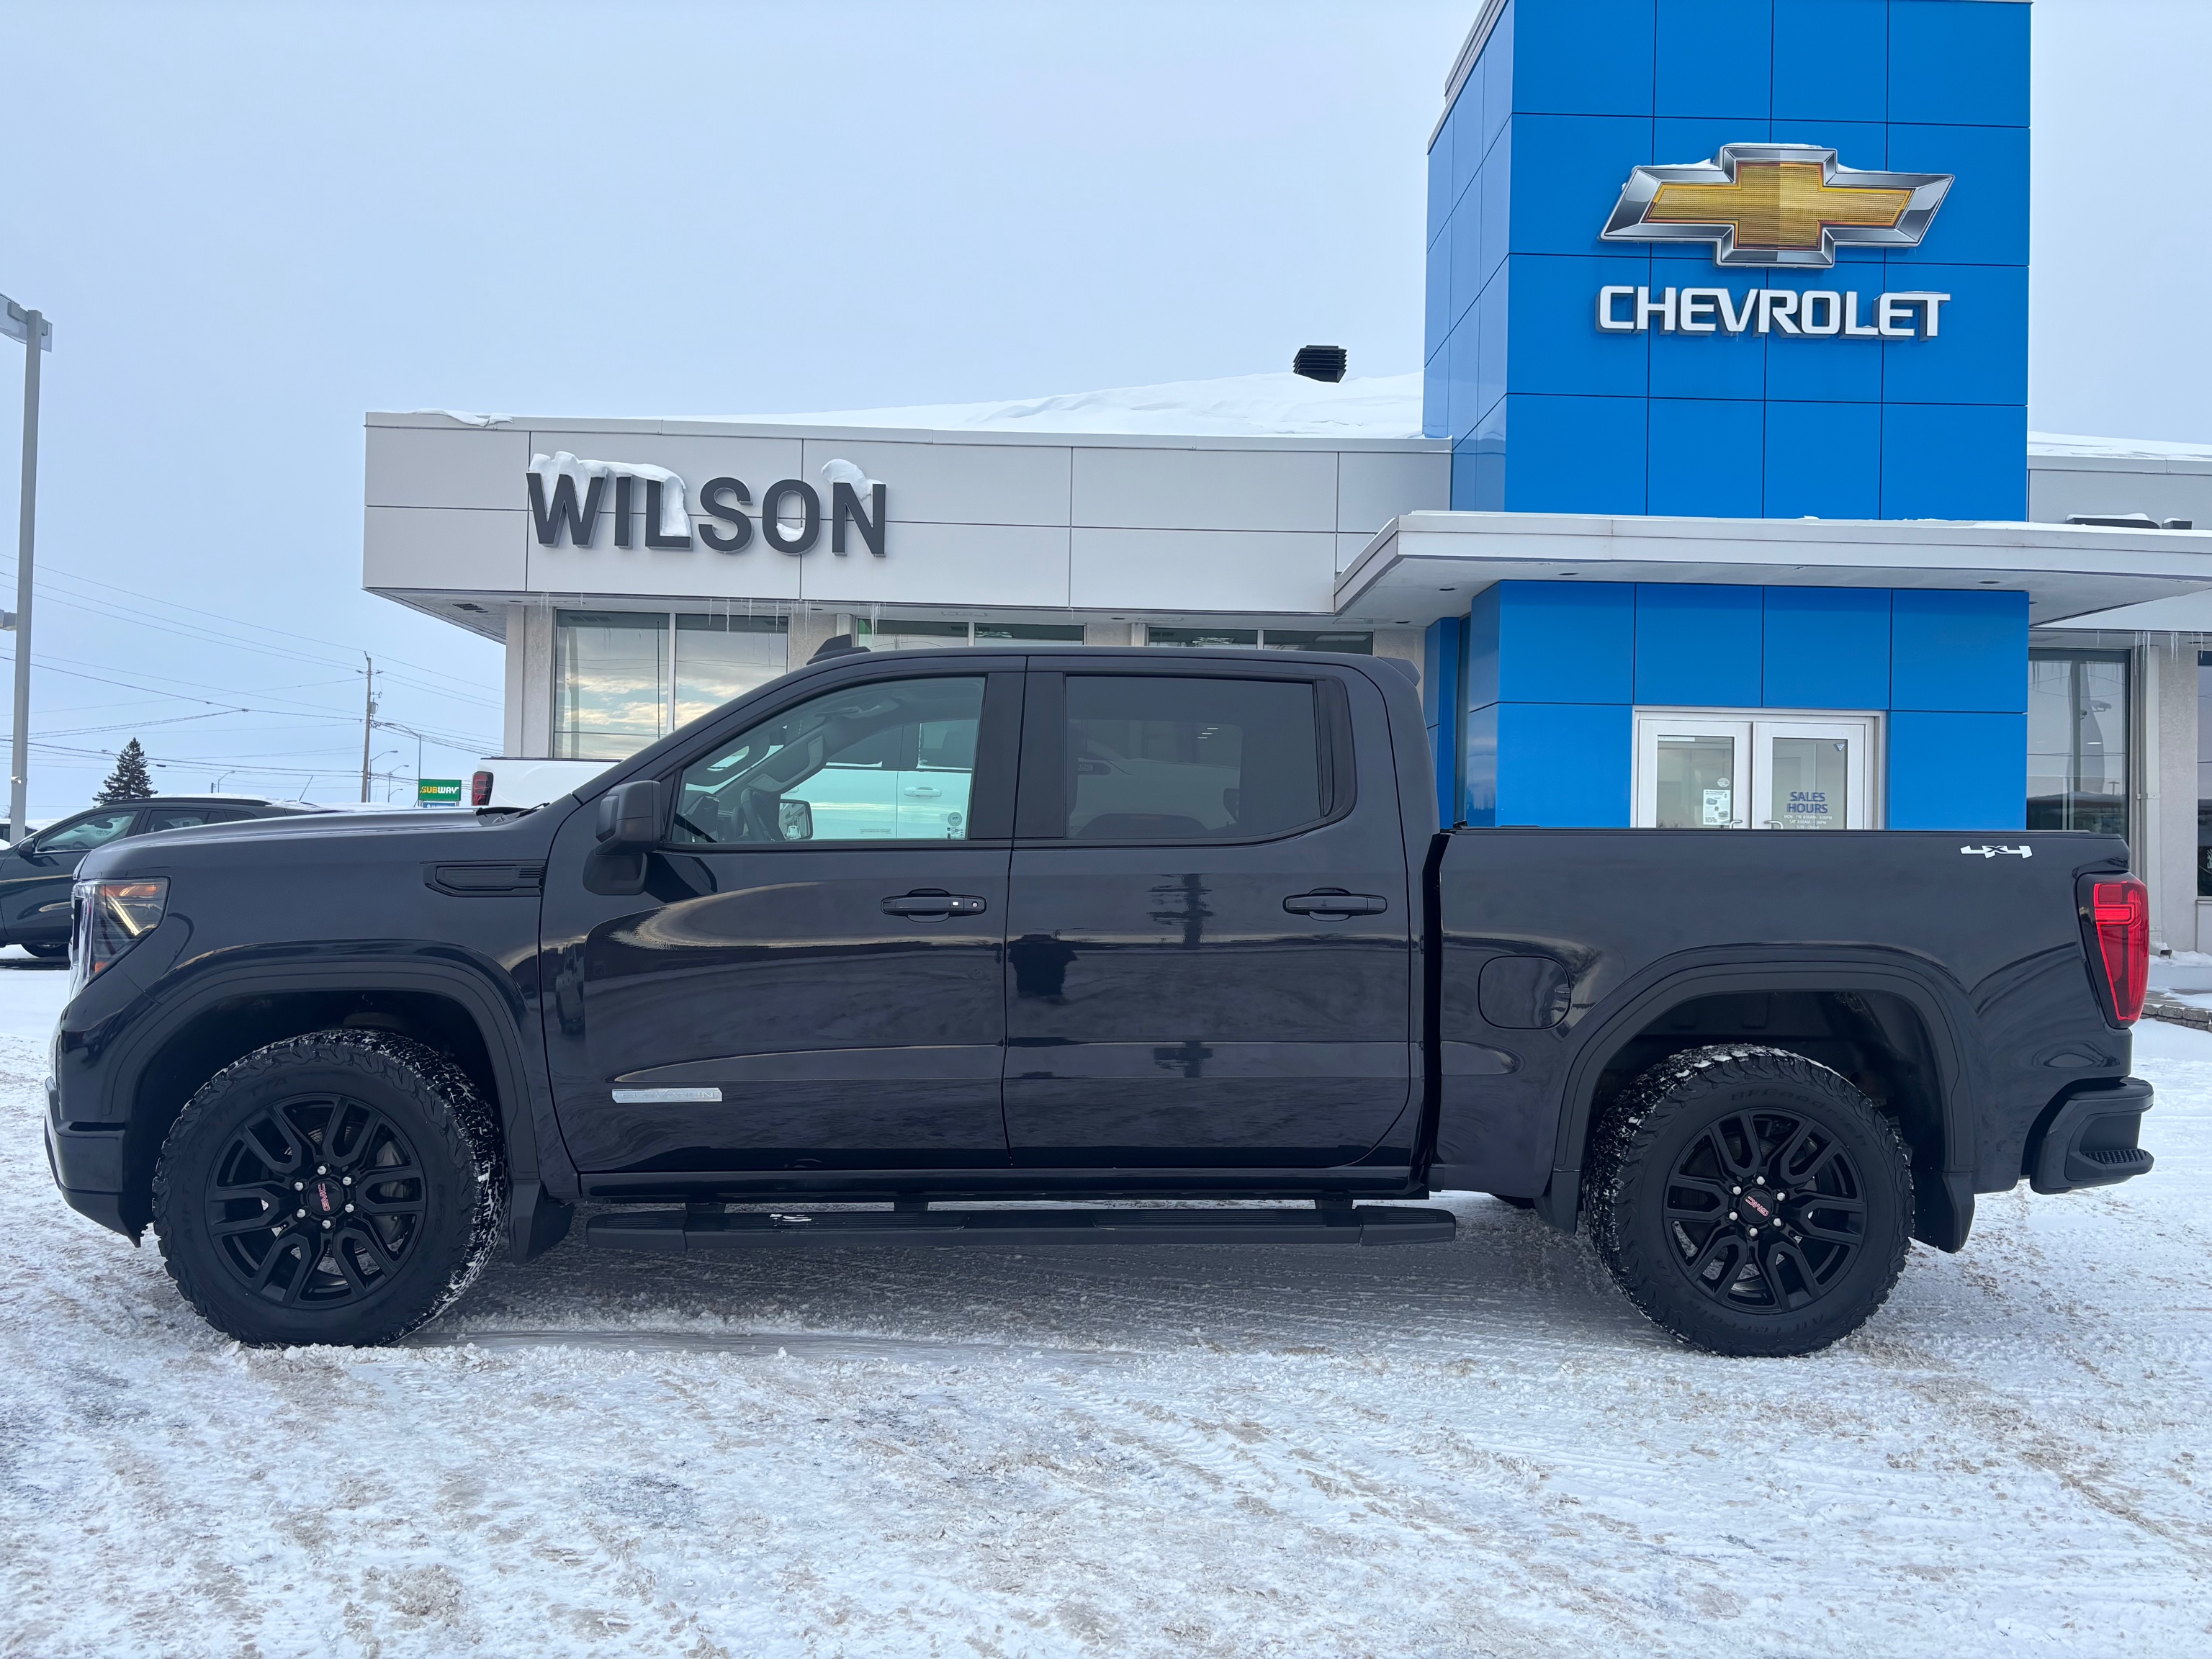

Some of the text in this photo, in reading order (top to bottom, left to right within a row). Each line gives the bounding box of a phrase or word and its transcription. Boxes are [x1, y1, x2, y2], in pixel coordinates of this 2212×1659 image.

[1597, 285, 1951, 339] CHEVROLET
[526, 471, 887, 557] WILSON
[420, 786, 459, 794] SUBWAY
[1789, 791, 1826, 802] SALES
[1787, 803, 1828, 814] HOURS
[318, 1183, 331, 1212] GMC
[1745, 1195, 1770, 1217] GMC
